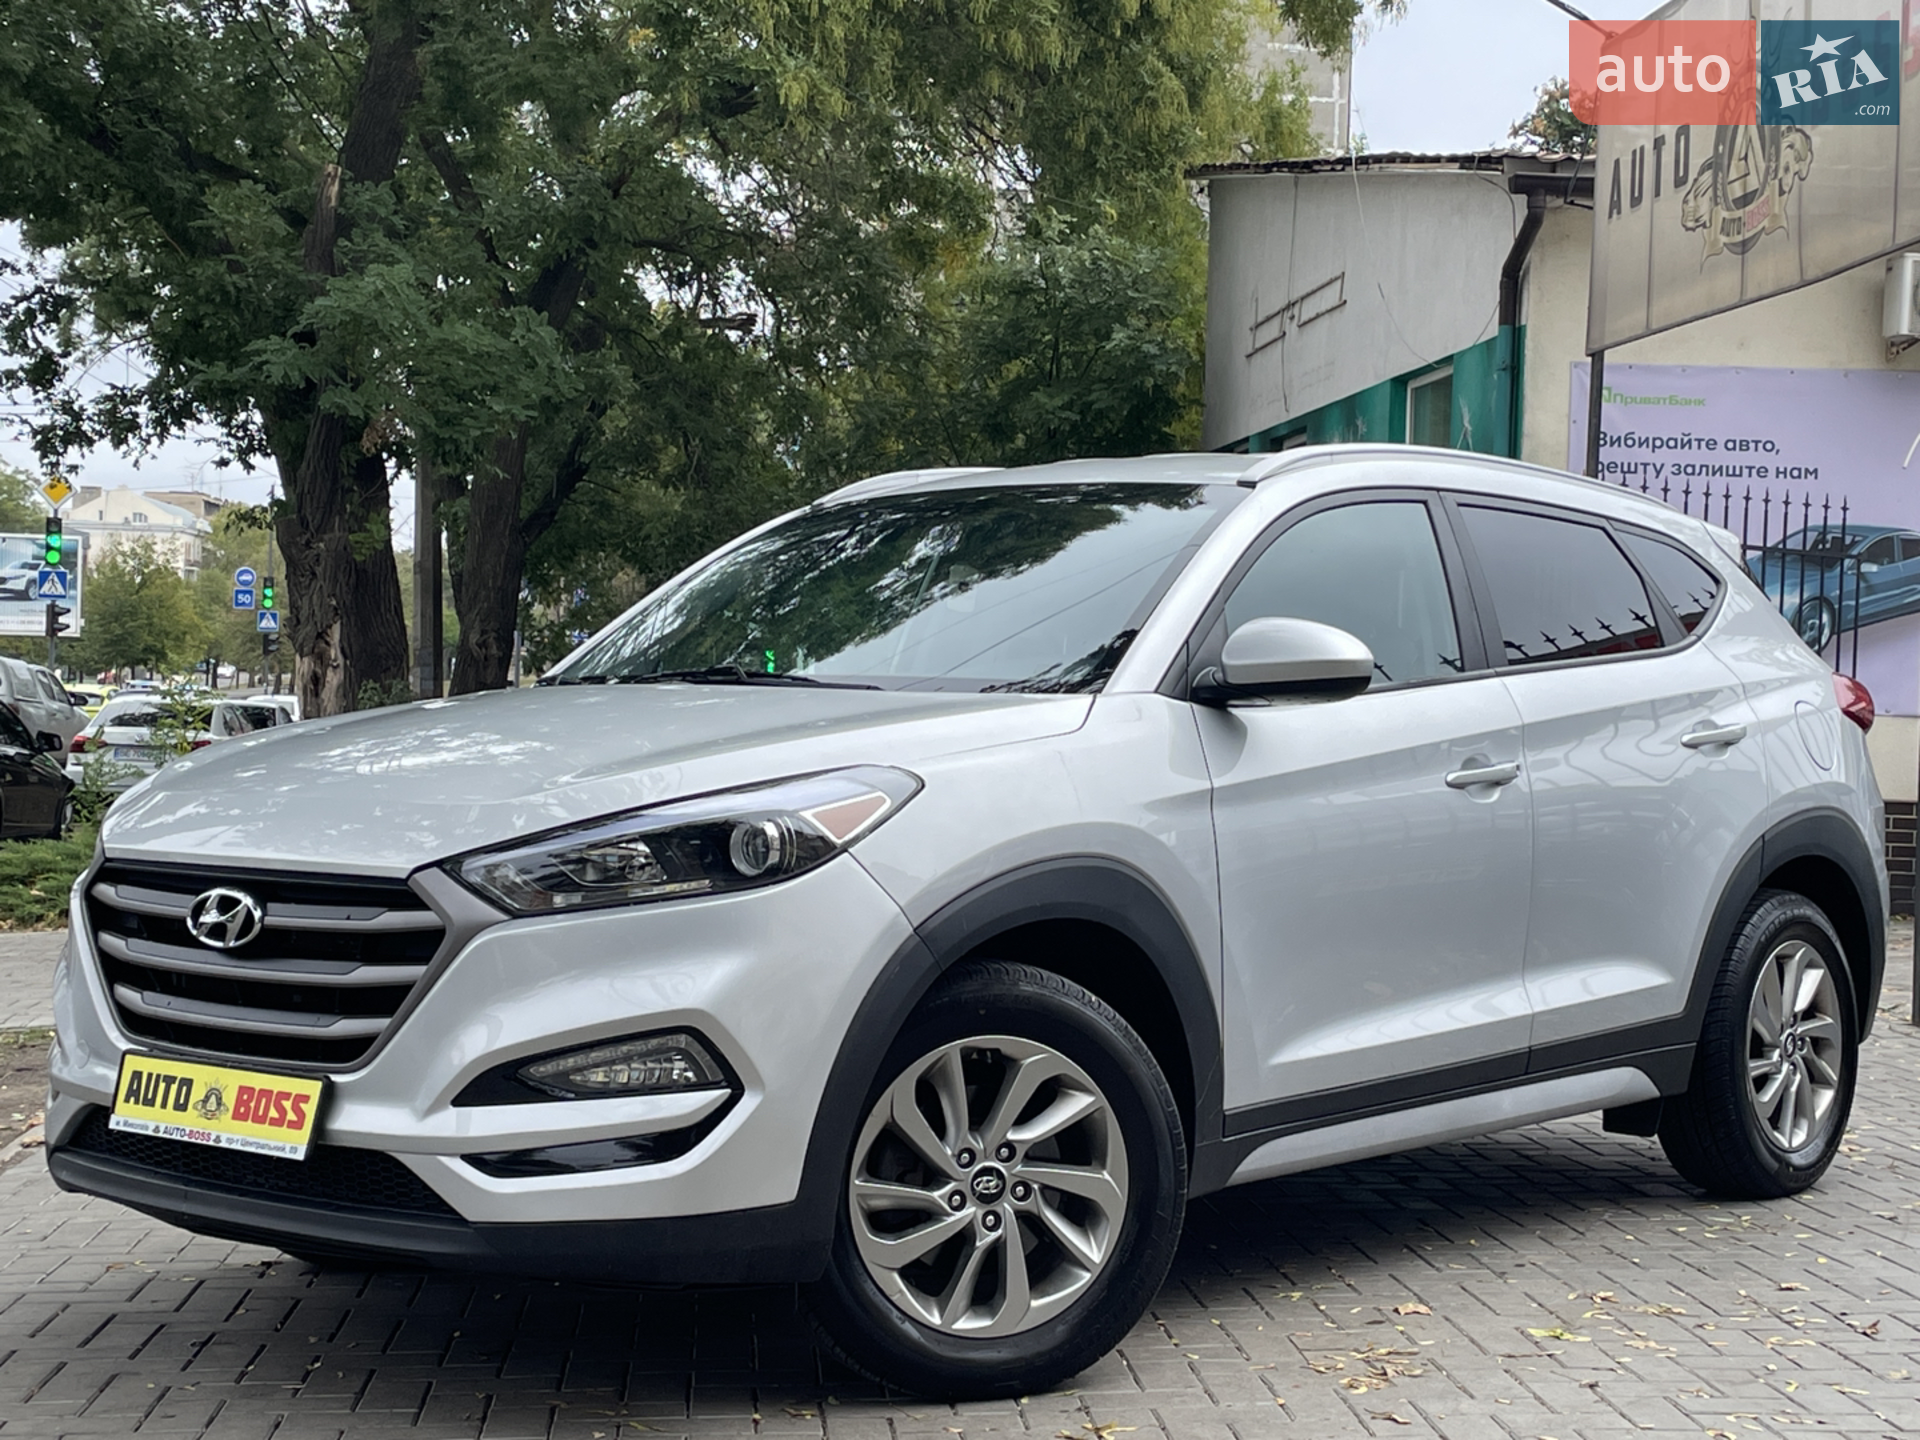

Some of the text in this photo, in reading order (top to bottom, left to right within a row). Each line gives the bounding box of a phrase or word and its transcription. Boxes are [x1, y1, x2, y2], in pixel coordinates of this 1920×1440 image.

[1607, 124, 1691, 220] AUTO
[1719, 216, 1742, 237] AUTO
[1723, 437, 1781, 455] авто,
[1670, 463, 1769, 478] залиште
[1775, 465, 1819, 480] нам
[237, 593, 251, 604] 50
[123, 1070, 311, 1131] AUTO BOSS
[162, 1125, 212, 1142] AUTO-BOSS
